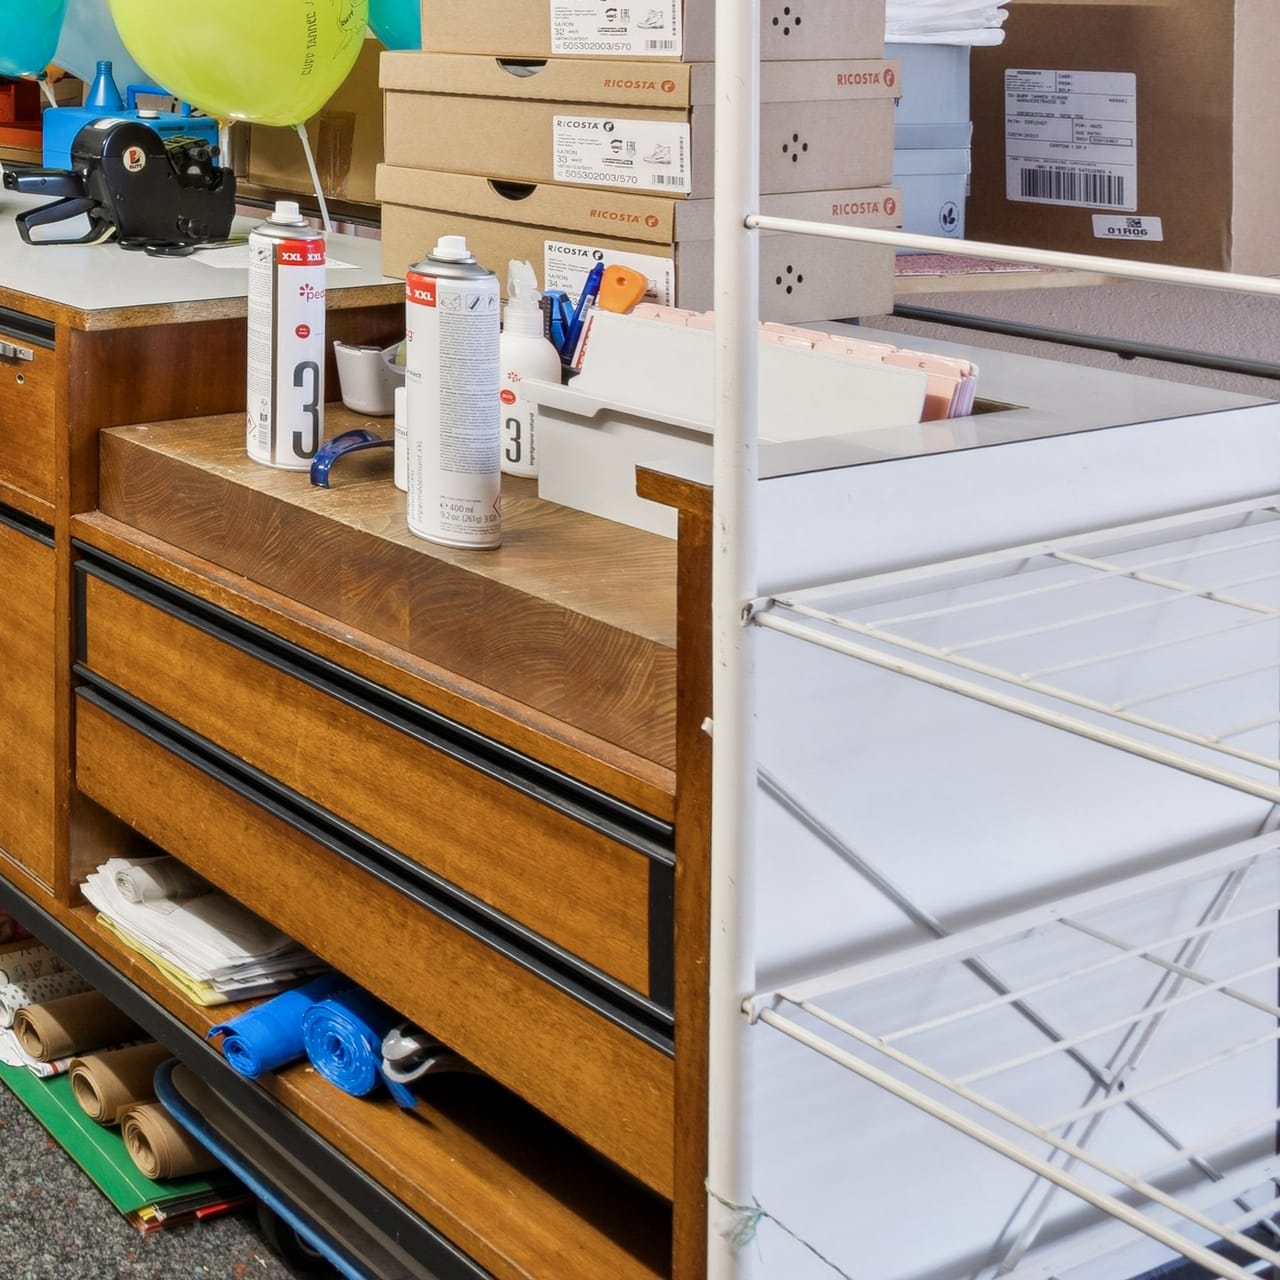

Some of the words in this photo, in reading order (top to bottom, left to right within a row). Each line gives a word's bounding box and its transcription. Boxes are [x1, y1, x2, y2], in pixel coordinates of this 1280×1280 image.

[563, 42, 632, 51] 505302003/570
[603, 78, 656, 91] RICOSTA
[837, 70, 882, 87] RICOSTA
[557, 120, 598, 129] RICOSTA
[565, 169, 638, 184] 505302003/570
[832, 200, 880, 216] RICOSTA
[590, 208, 641, 223] RICOSTA
[1107, 226, 1148, 236] 01R06
[282, 252, 302, 261] XXL
[307, 253, 321, 261] XXL
[548, 244, 589, 257] RICOSTA
[414, 288, 433, 301] XXL
[293, 360, 320, 460] 3
[505, 417, 522, 463] 3
